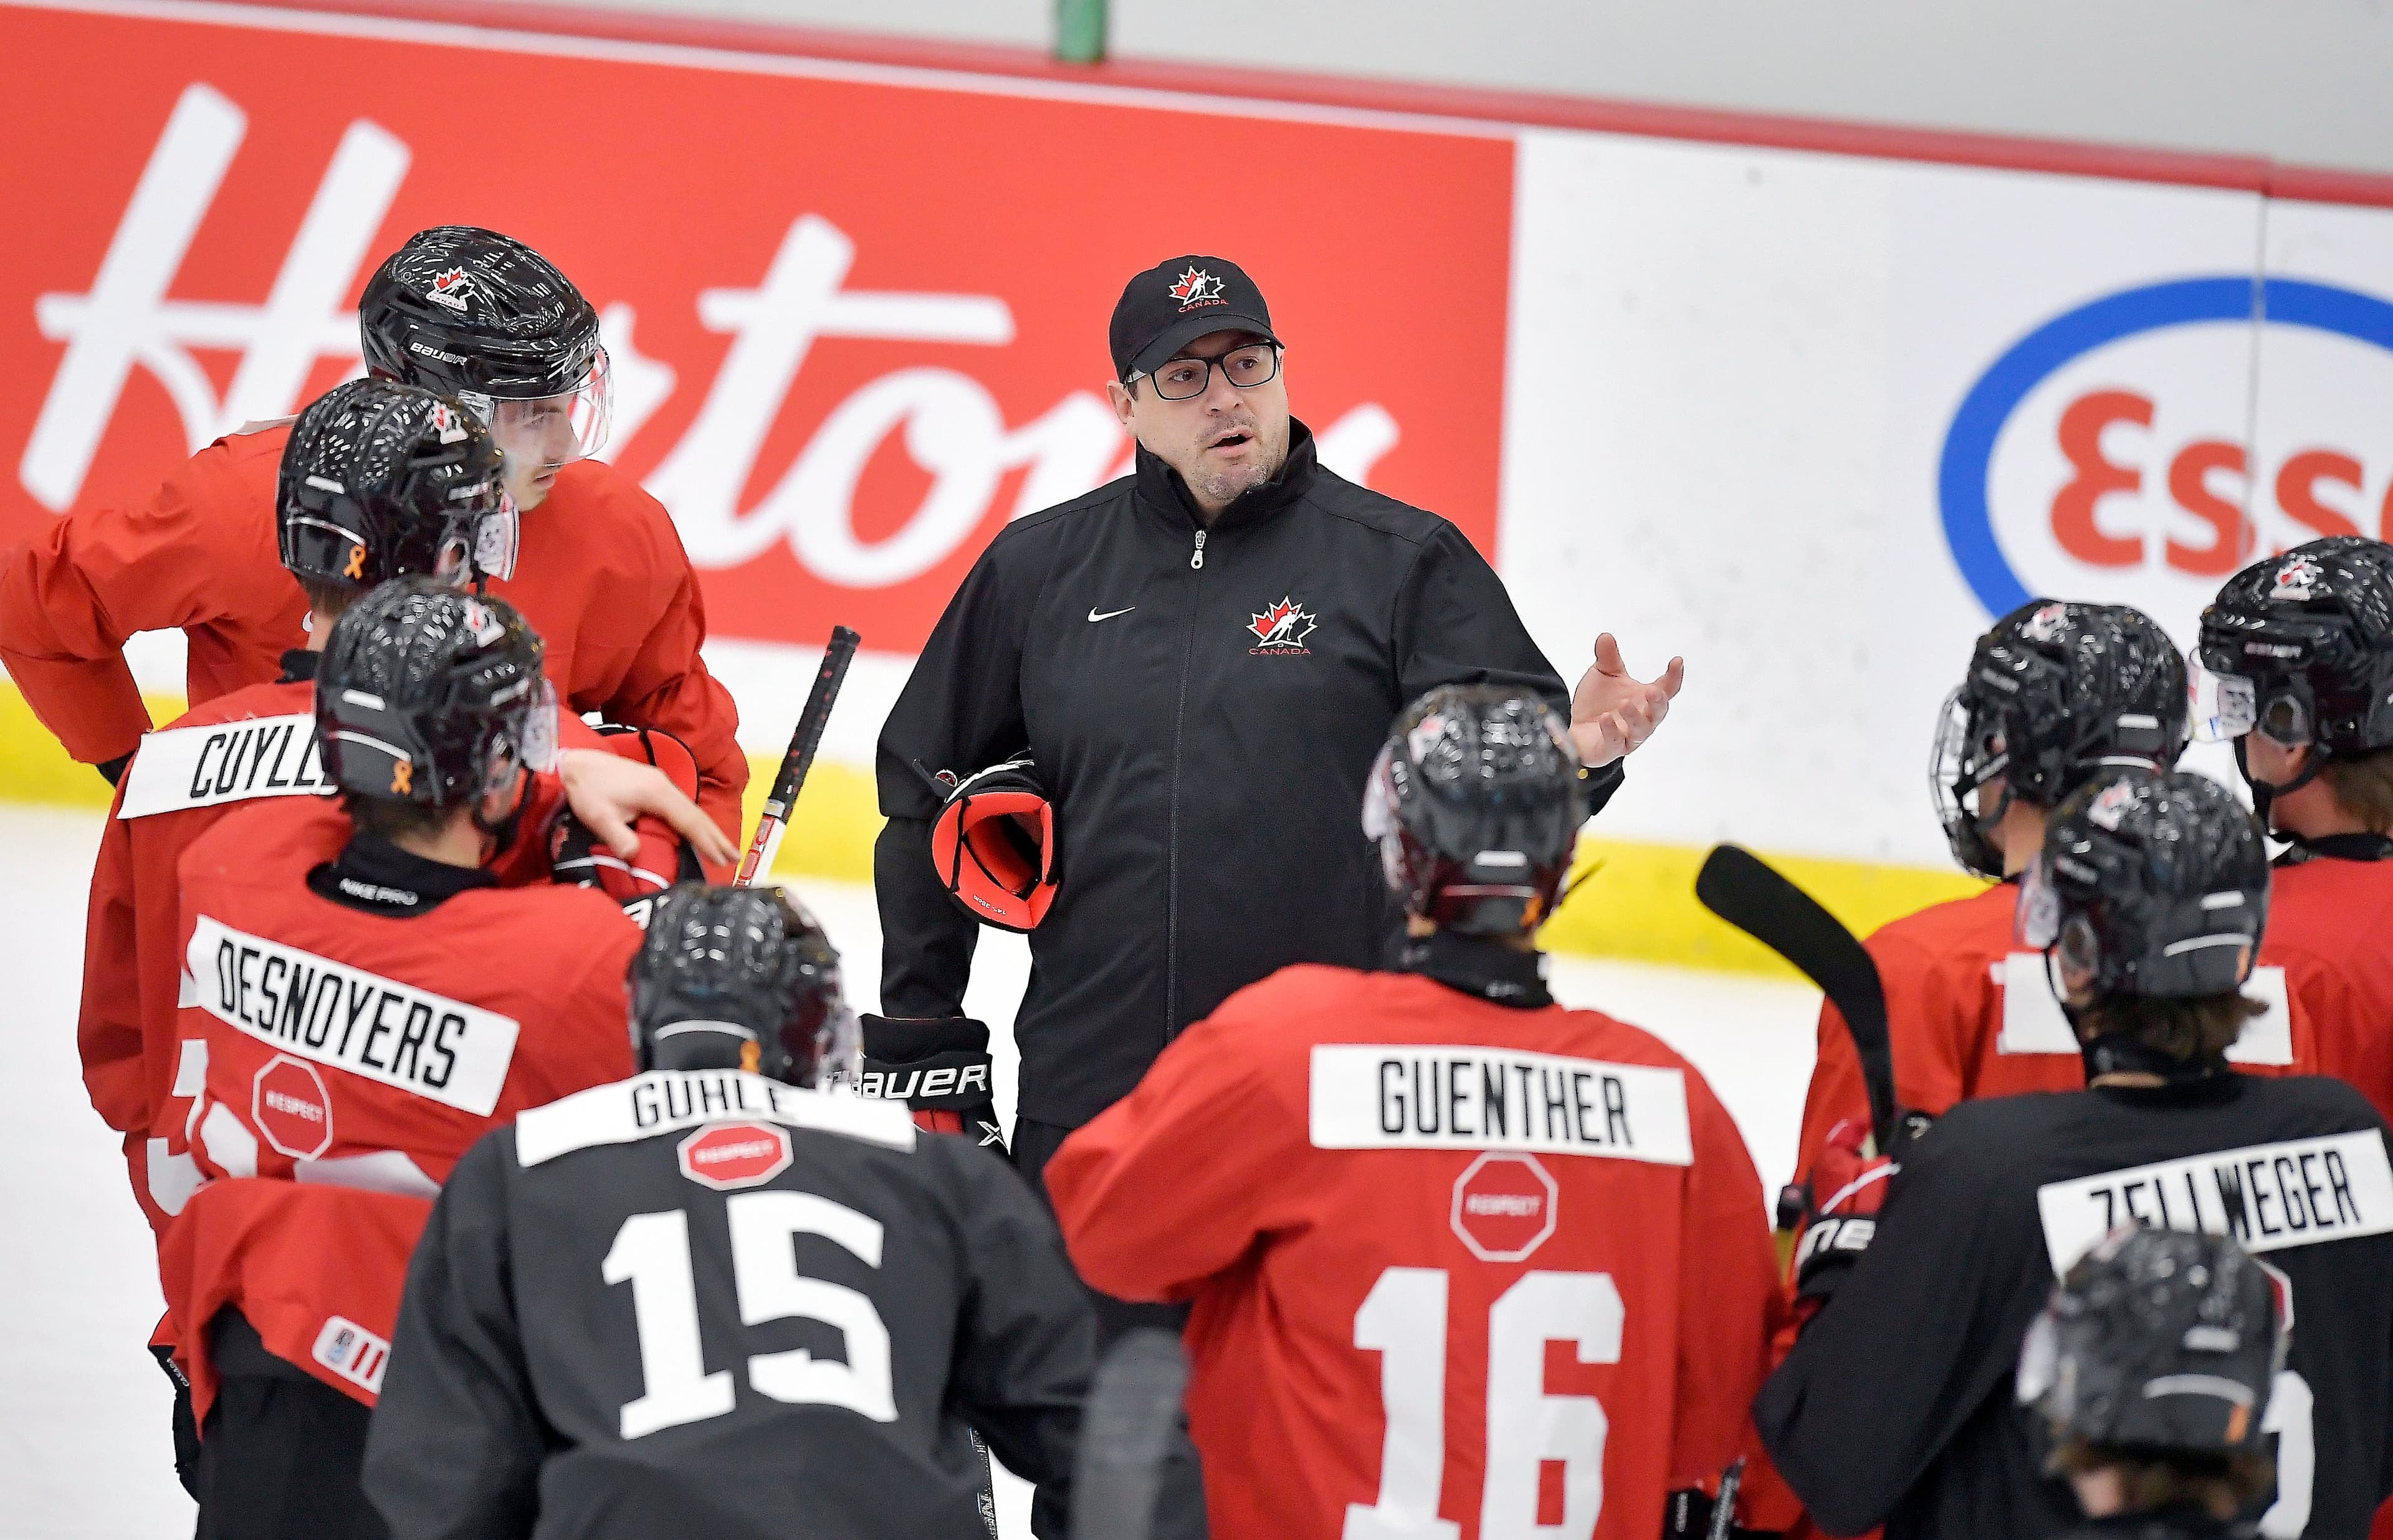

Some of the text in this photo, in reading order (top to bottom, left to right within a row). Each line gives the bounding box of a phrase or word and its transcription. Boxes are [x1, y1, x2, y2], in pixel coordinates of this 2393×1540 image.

[429, 295, 466, 310] CANADA
[1178, 299, 1229, 313] CANADA
[409, 342, 468, 366] BAUER
[2048, 387, 2393, 580] Ess
[189, 725, 337, 799] CUYLL
[218, 938, 466, 1089] DESNOYERS
[631, 1078, 796, 1129] GUHLE
[1380, 1060, 1633, 1146] GUENTHER
[600, 1189, 899, 1440] 15
[1342, 1266, 1626, 1540] 16
